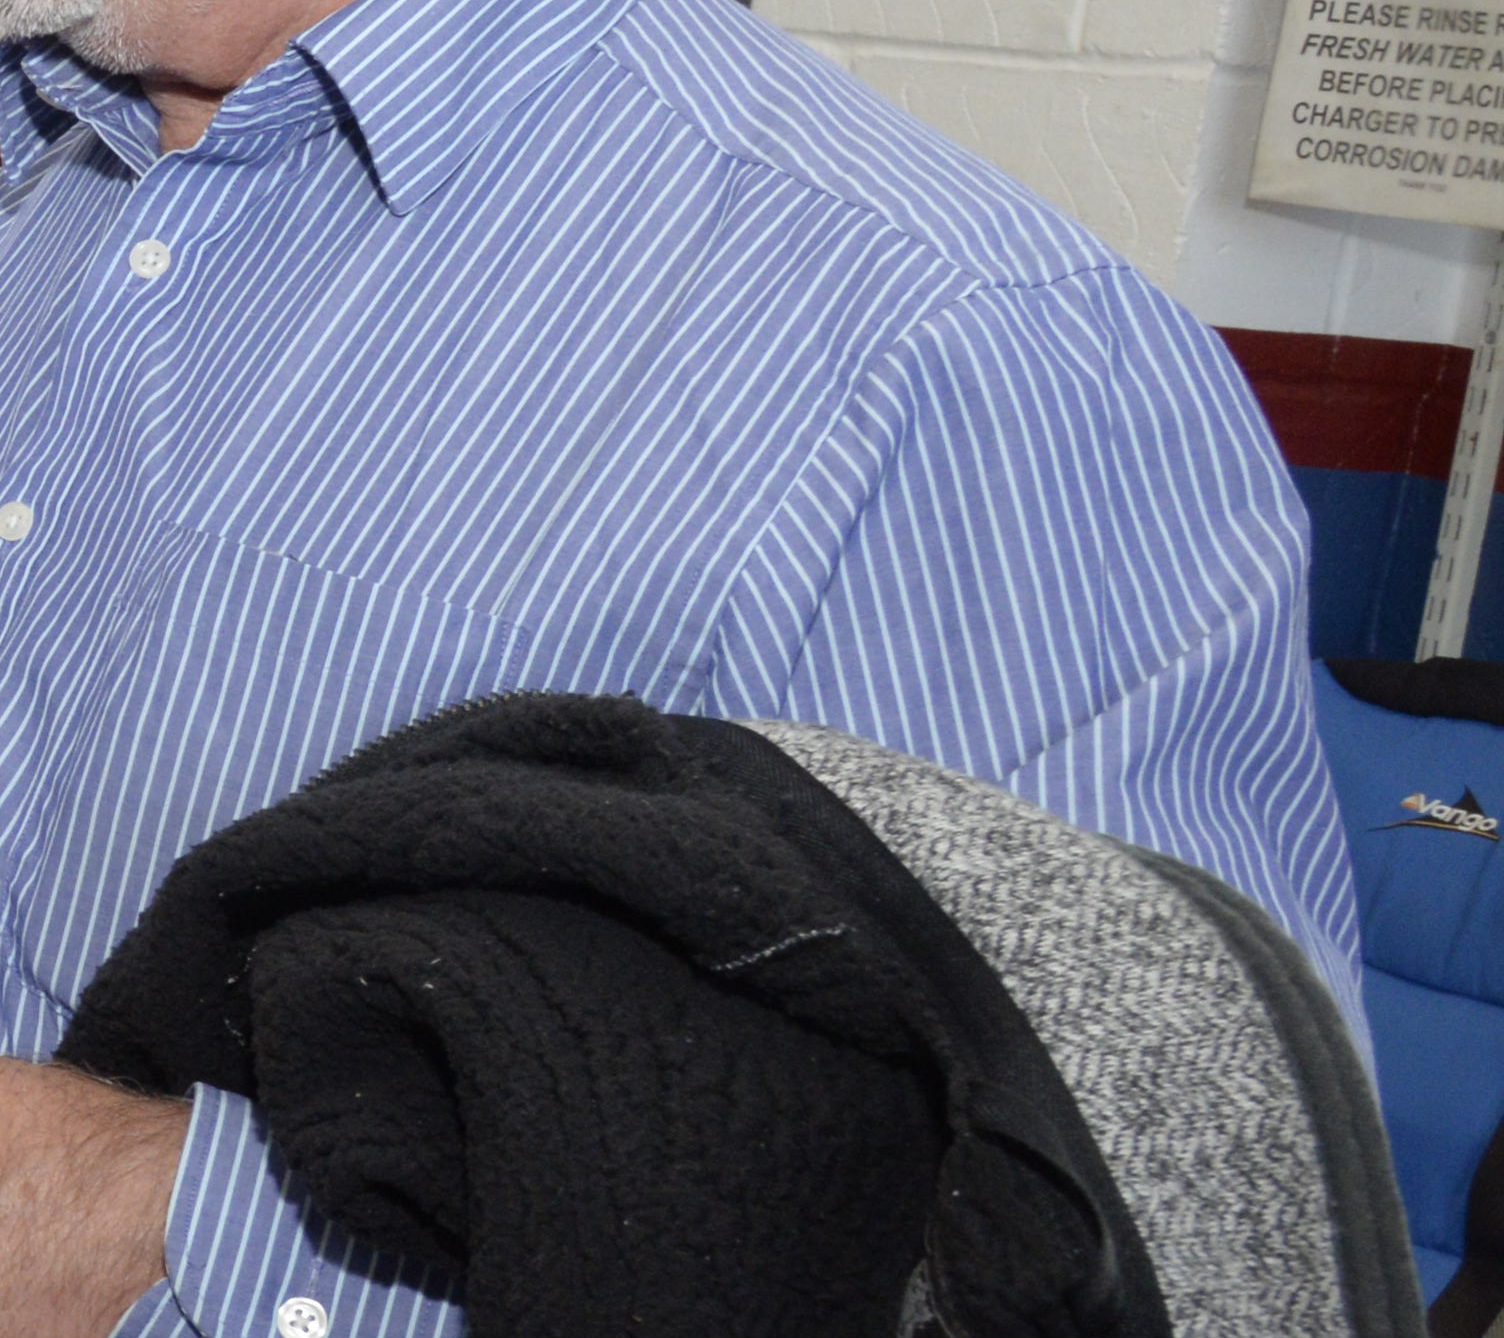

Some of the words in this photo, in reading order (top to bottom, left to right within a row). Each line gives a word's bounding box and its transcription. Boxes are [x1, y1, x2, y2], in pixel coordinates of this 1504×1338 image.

[1309, 0, 1411, 28] PLEASE
[1417, 7, 1487, 35] RINSE
[1301, 34, 1391, 62] FRESH
[1396, 41, 1484, 71] WATER
[1319, 69, 1422, 101] BEFORE
[1429, 80, 1504, 109] PLACI
[1292, 102, 1419, 137] CHARGER
[1426, 115, 1457, 141] TO
[1296, 137, 1446, 176] CORROSION
